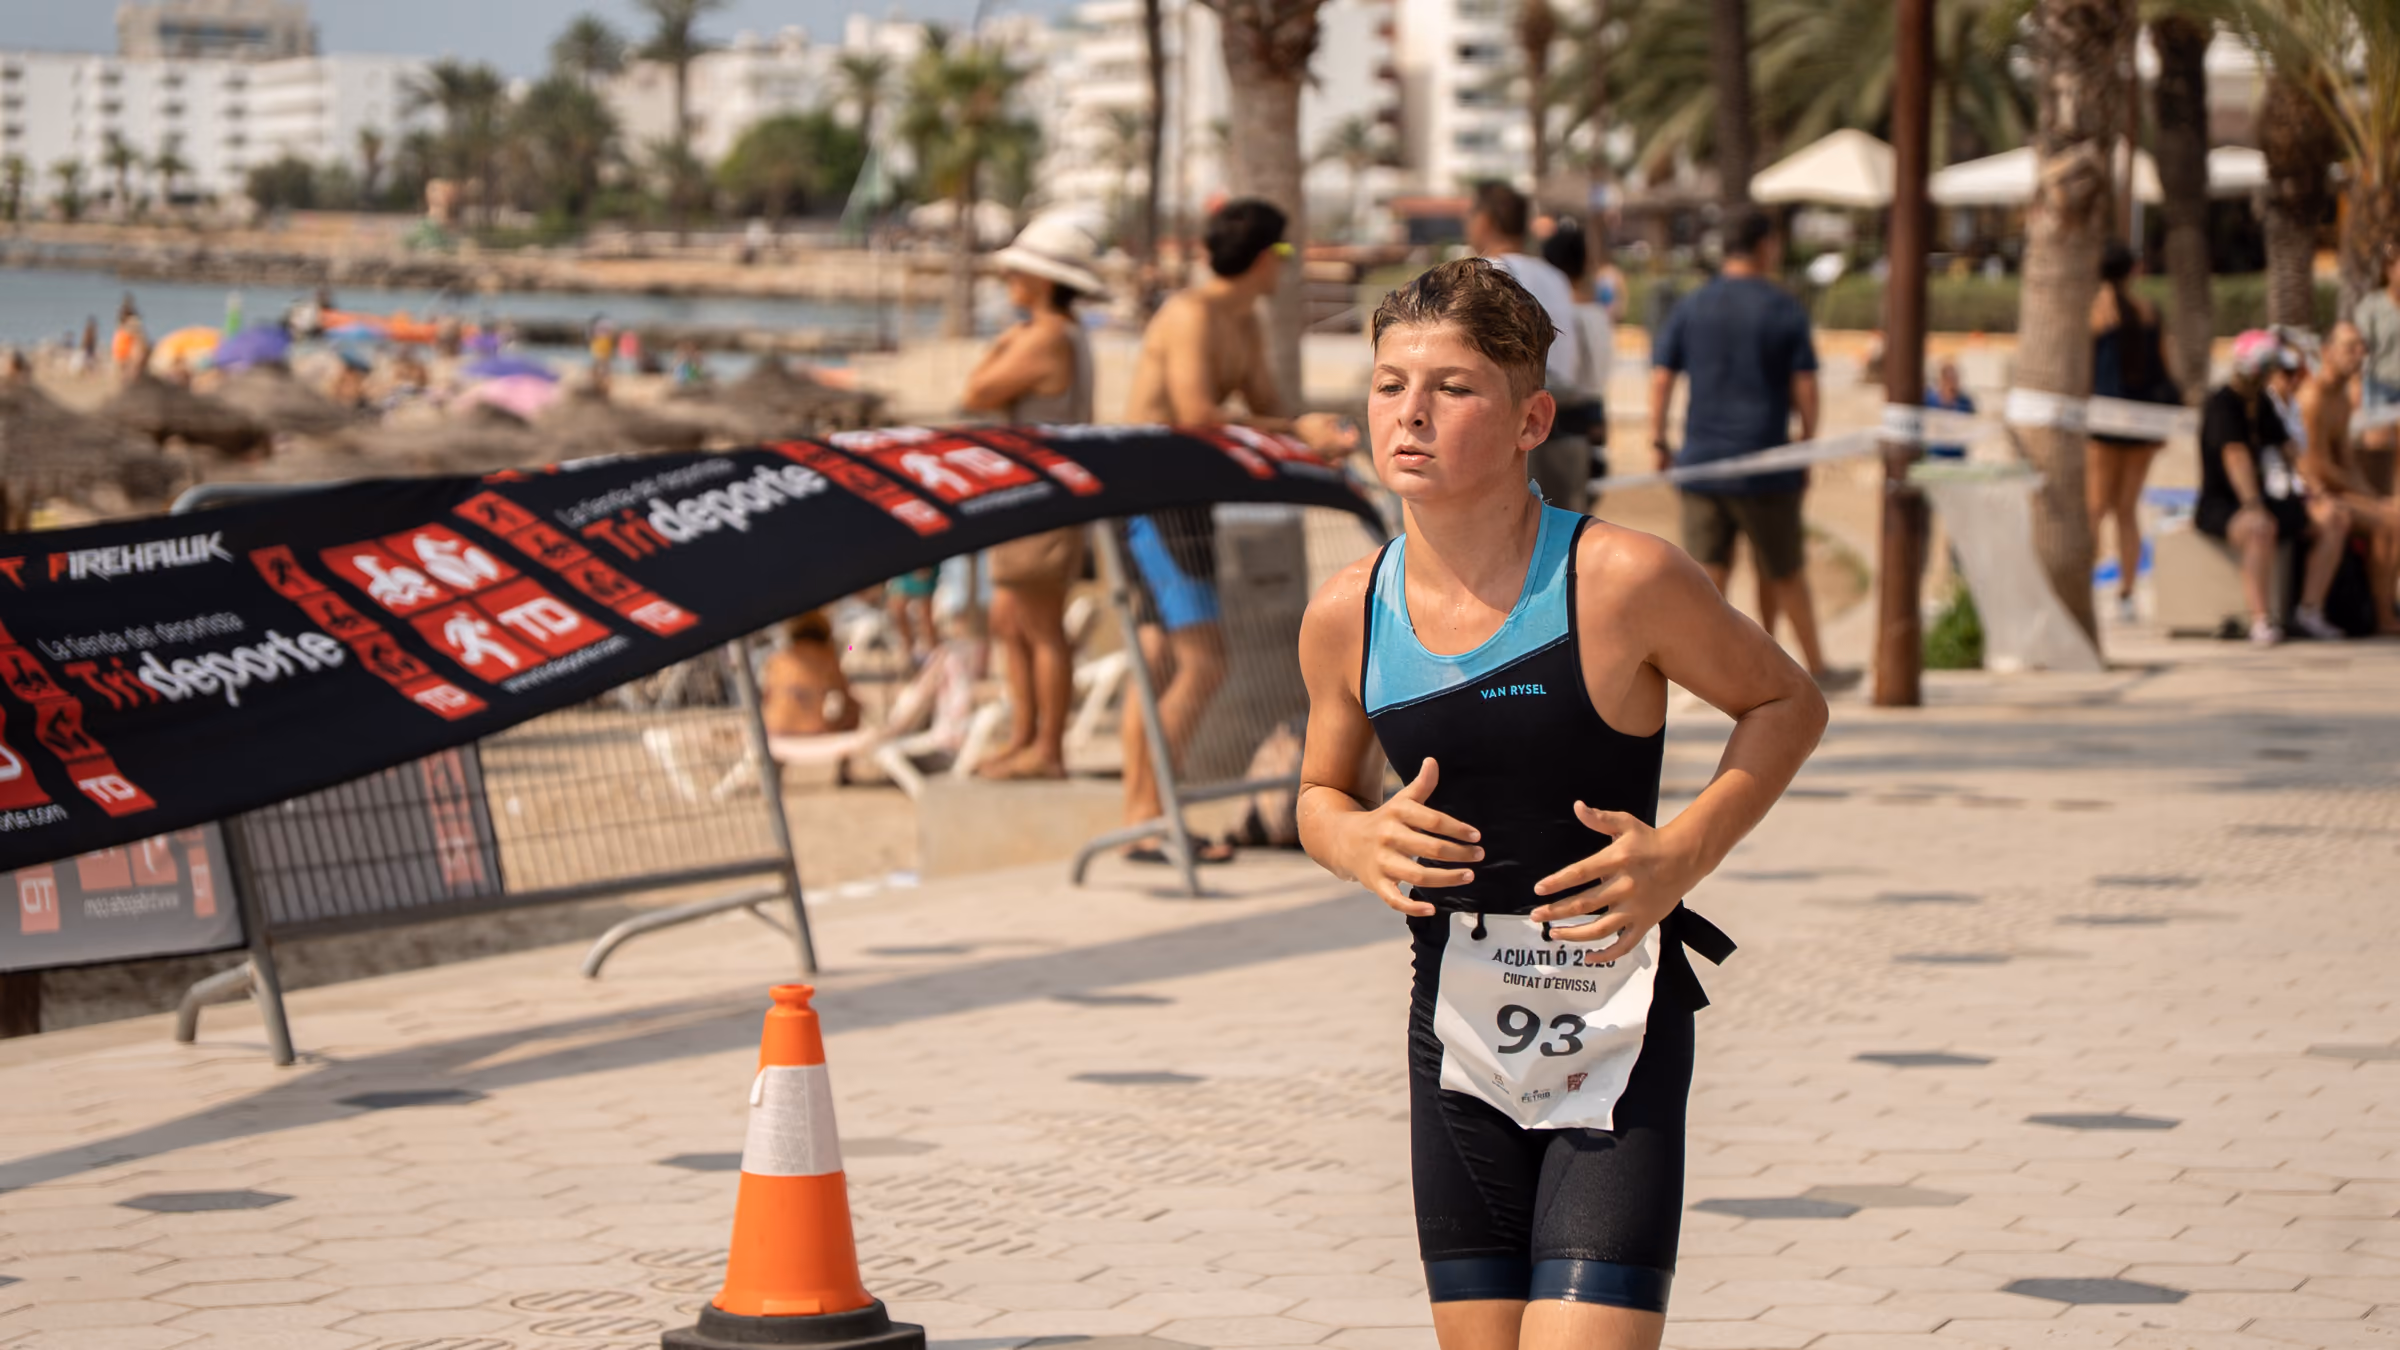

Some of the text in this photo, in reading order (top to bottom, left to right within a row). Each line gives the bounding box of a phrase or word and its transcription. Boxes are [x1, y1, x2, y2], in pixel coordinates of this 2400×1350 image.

[498, 597, 580, 643] TD
[37, 637, 72, 661] La
[1480, 683, 1547, 700] VAN RYSEL
[78, 773, 137, 804] TD
[1503, 971, 1542, 989] CIUTAT
[1496, 1003, 1587, 1057] 93
